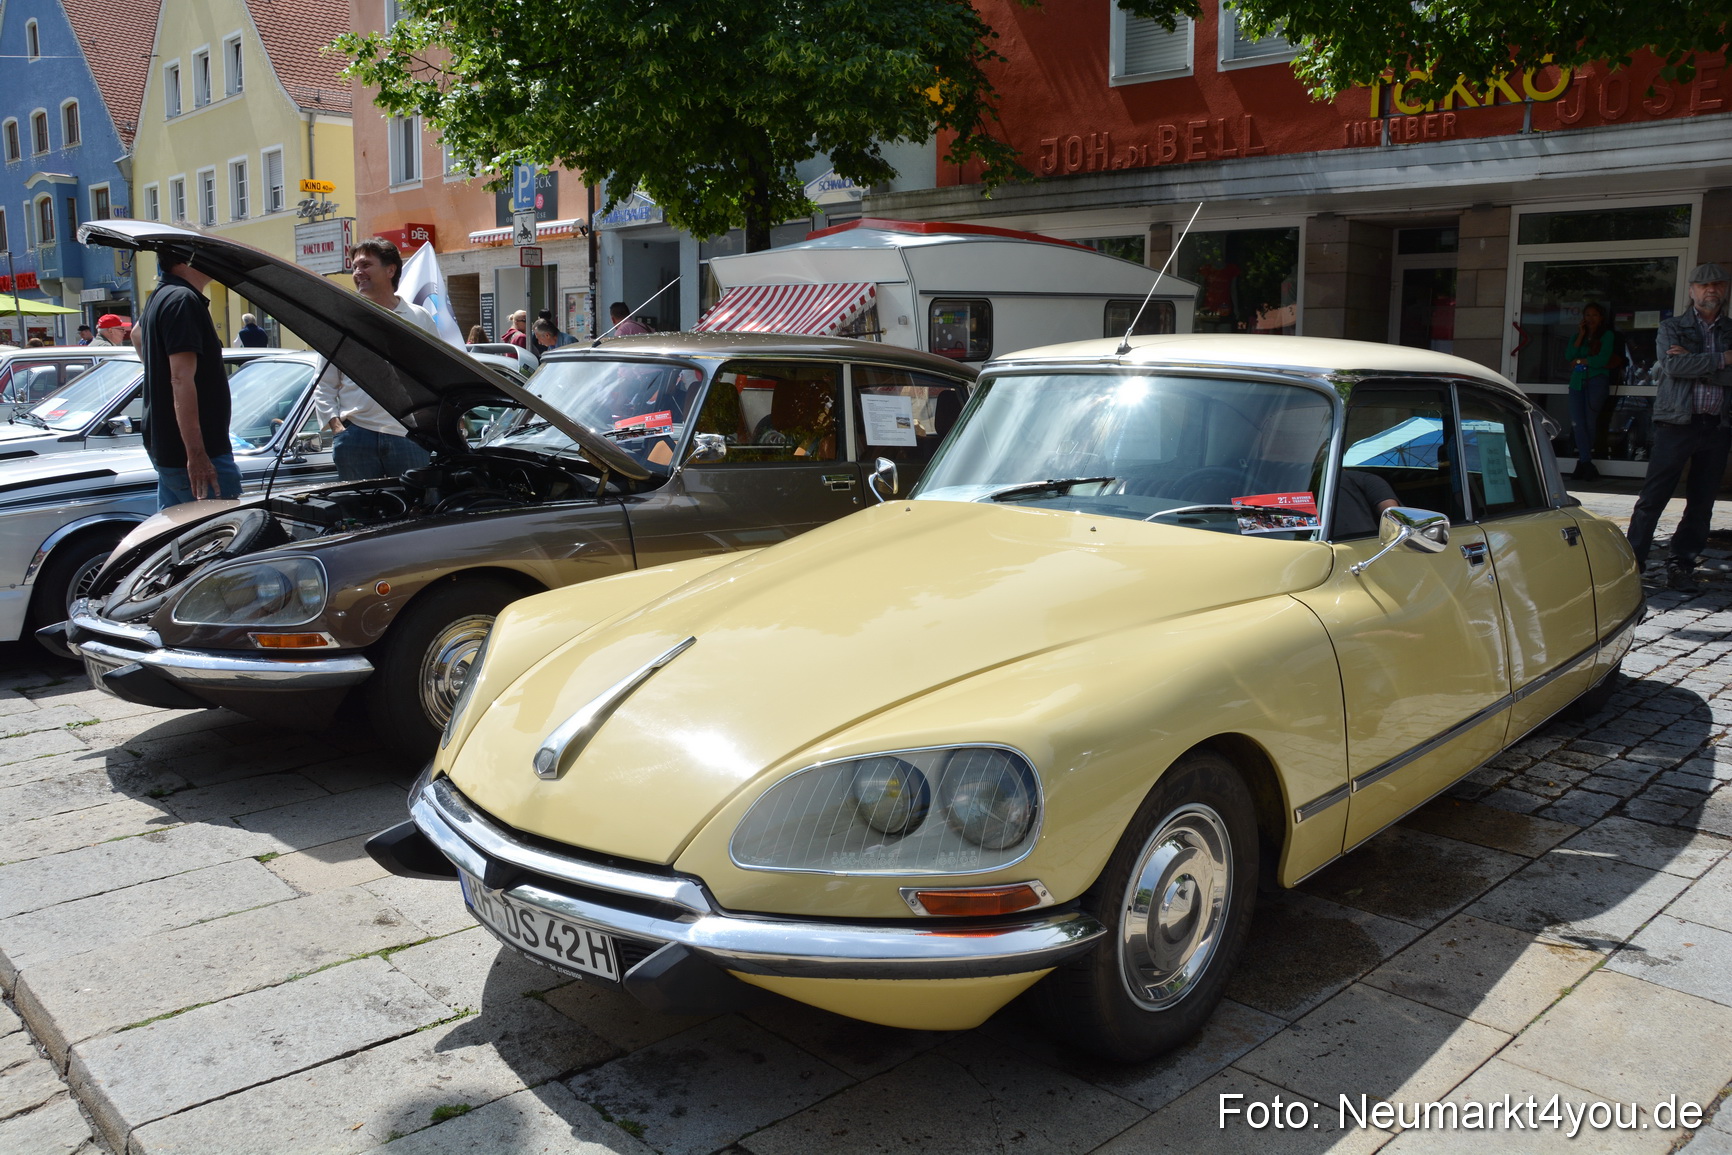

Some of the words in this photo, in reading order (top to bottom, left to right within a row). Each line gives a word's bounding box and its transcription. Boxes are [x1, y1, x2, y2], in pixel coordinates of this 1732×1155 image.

[1158, 115, 1265, 164] BELL
[1344, 113, 1457, 146] INHABER
[304, 182, 321, 190] KINO
[519, 166, 531, 203] P
[321, 241, 335, 253] KINO
[343, 220, 352, 270] KINO
[411, 228, 430, 241] DER
[503, 901, 540, 948] DS
[545, 920, 614, 974] 42H
